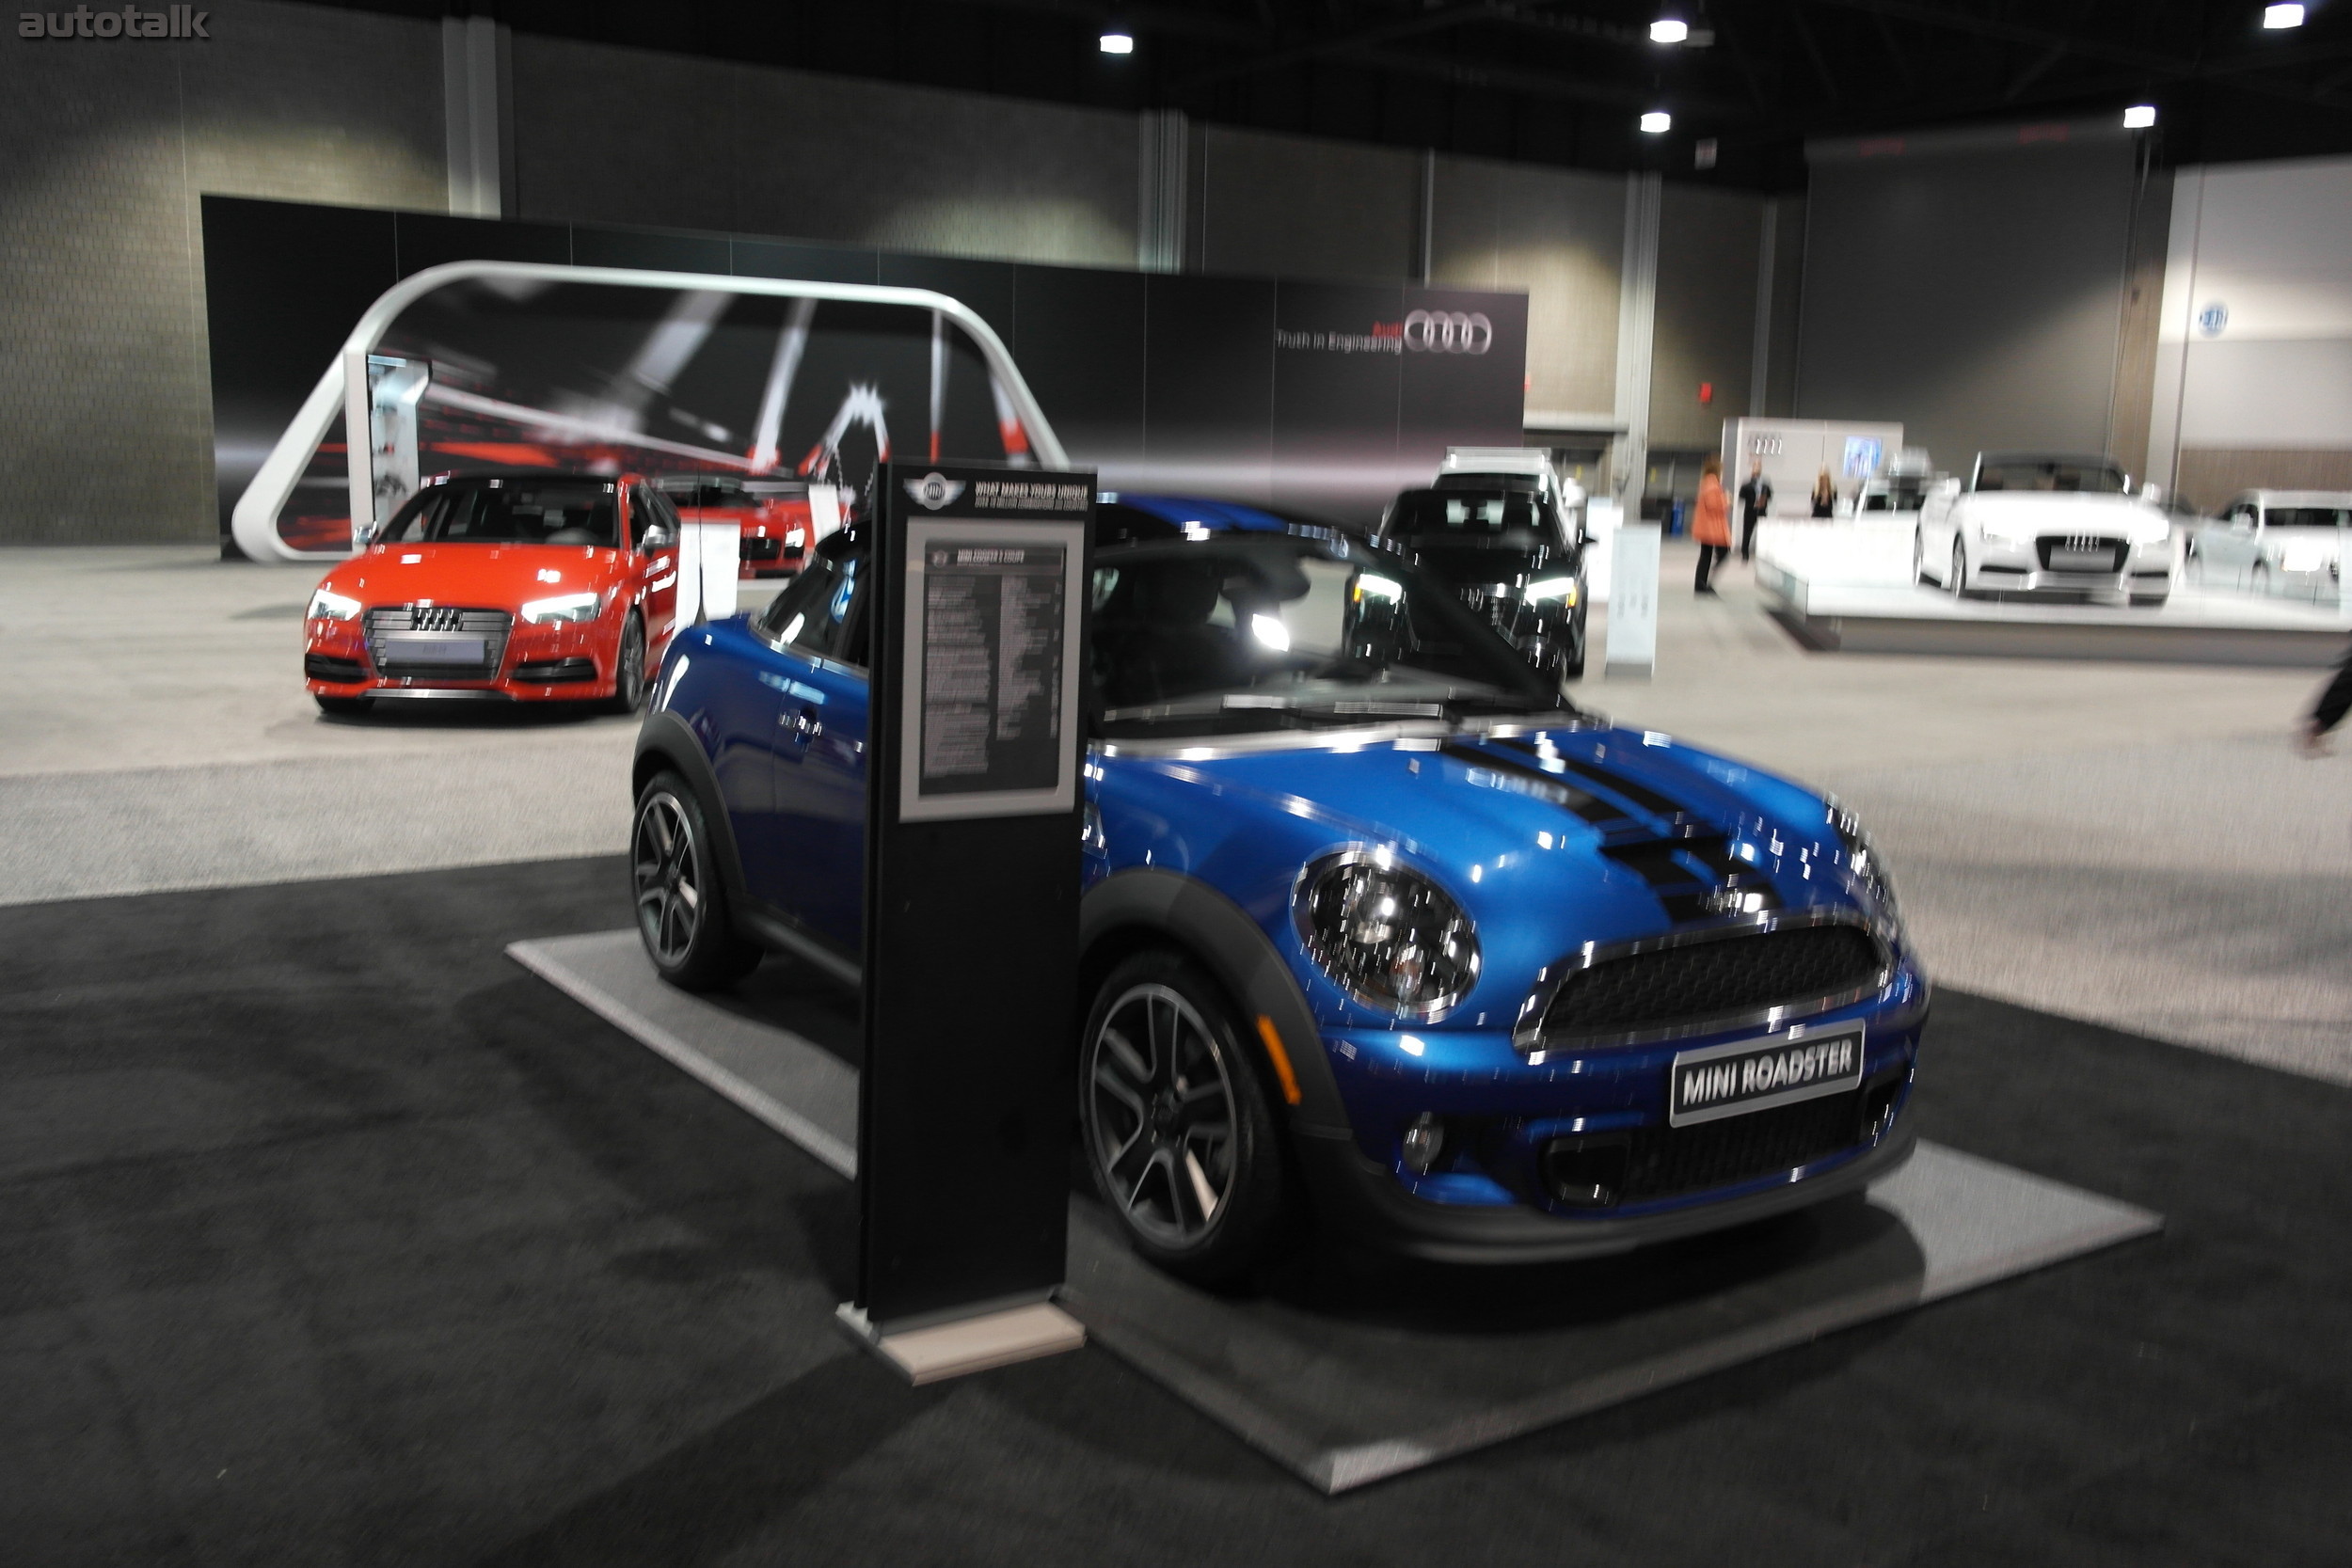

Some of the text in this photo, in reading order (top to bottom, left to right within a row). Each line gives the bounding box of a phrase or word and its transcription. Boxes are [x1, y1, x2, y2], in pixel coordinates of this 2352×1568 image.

[1372, 321, 1403, 337] Audi
[1277, 329, 1402, 355] Truth in Engineering
[975, 482, 1089, 500] WHAT MAKES YOURS UNIQUE
[957, 549, 973, 562] MINI
[973, 549, 998, 563] COOPER
[1004, 549, 1025, 564] COUPE
[1682, 1038, 1852, 1106] MINI ROADSTER
